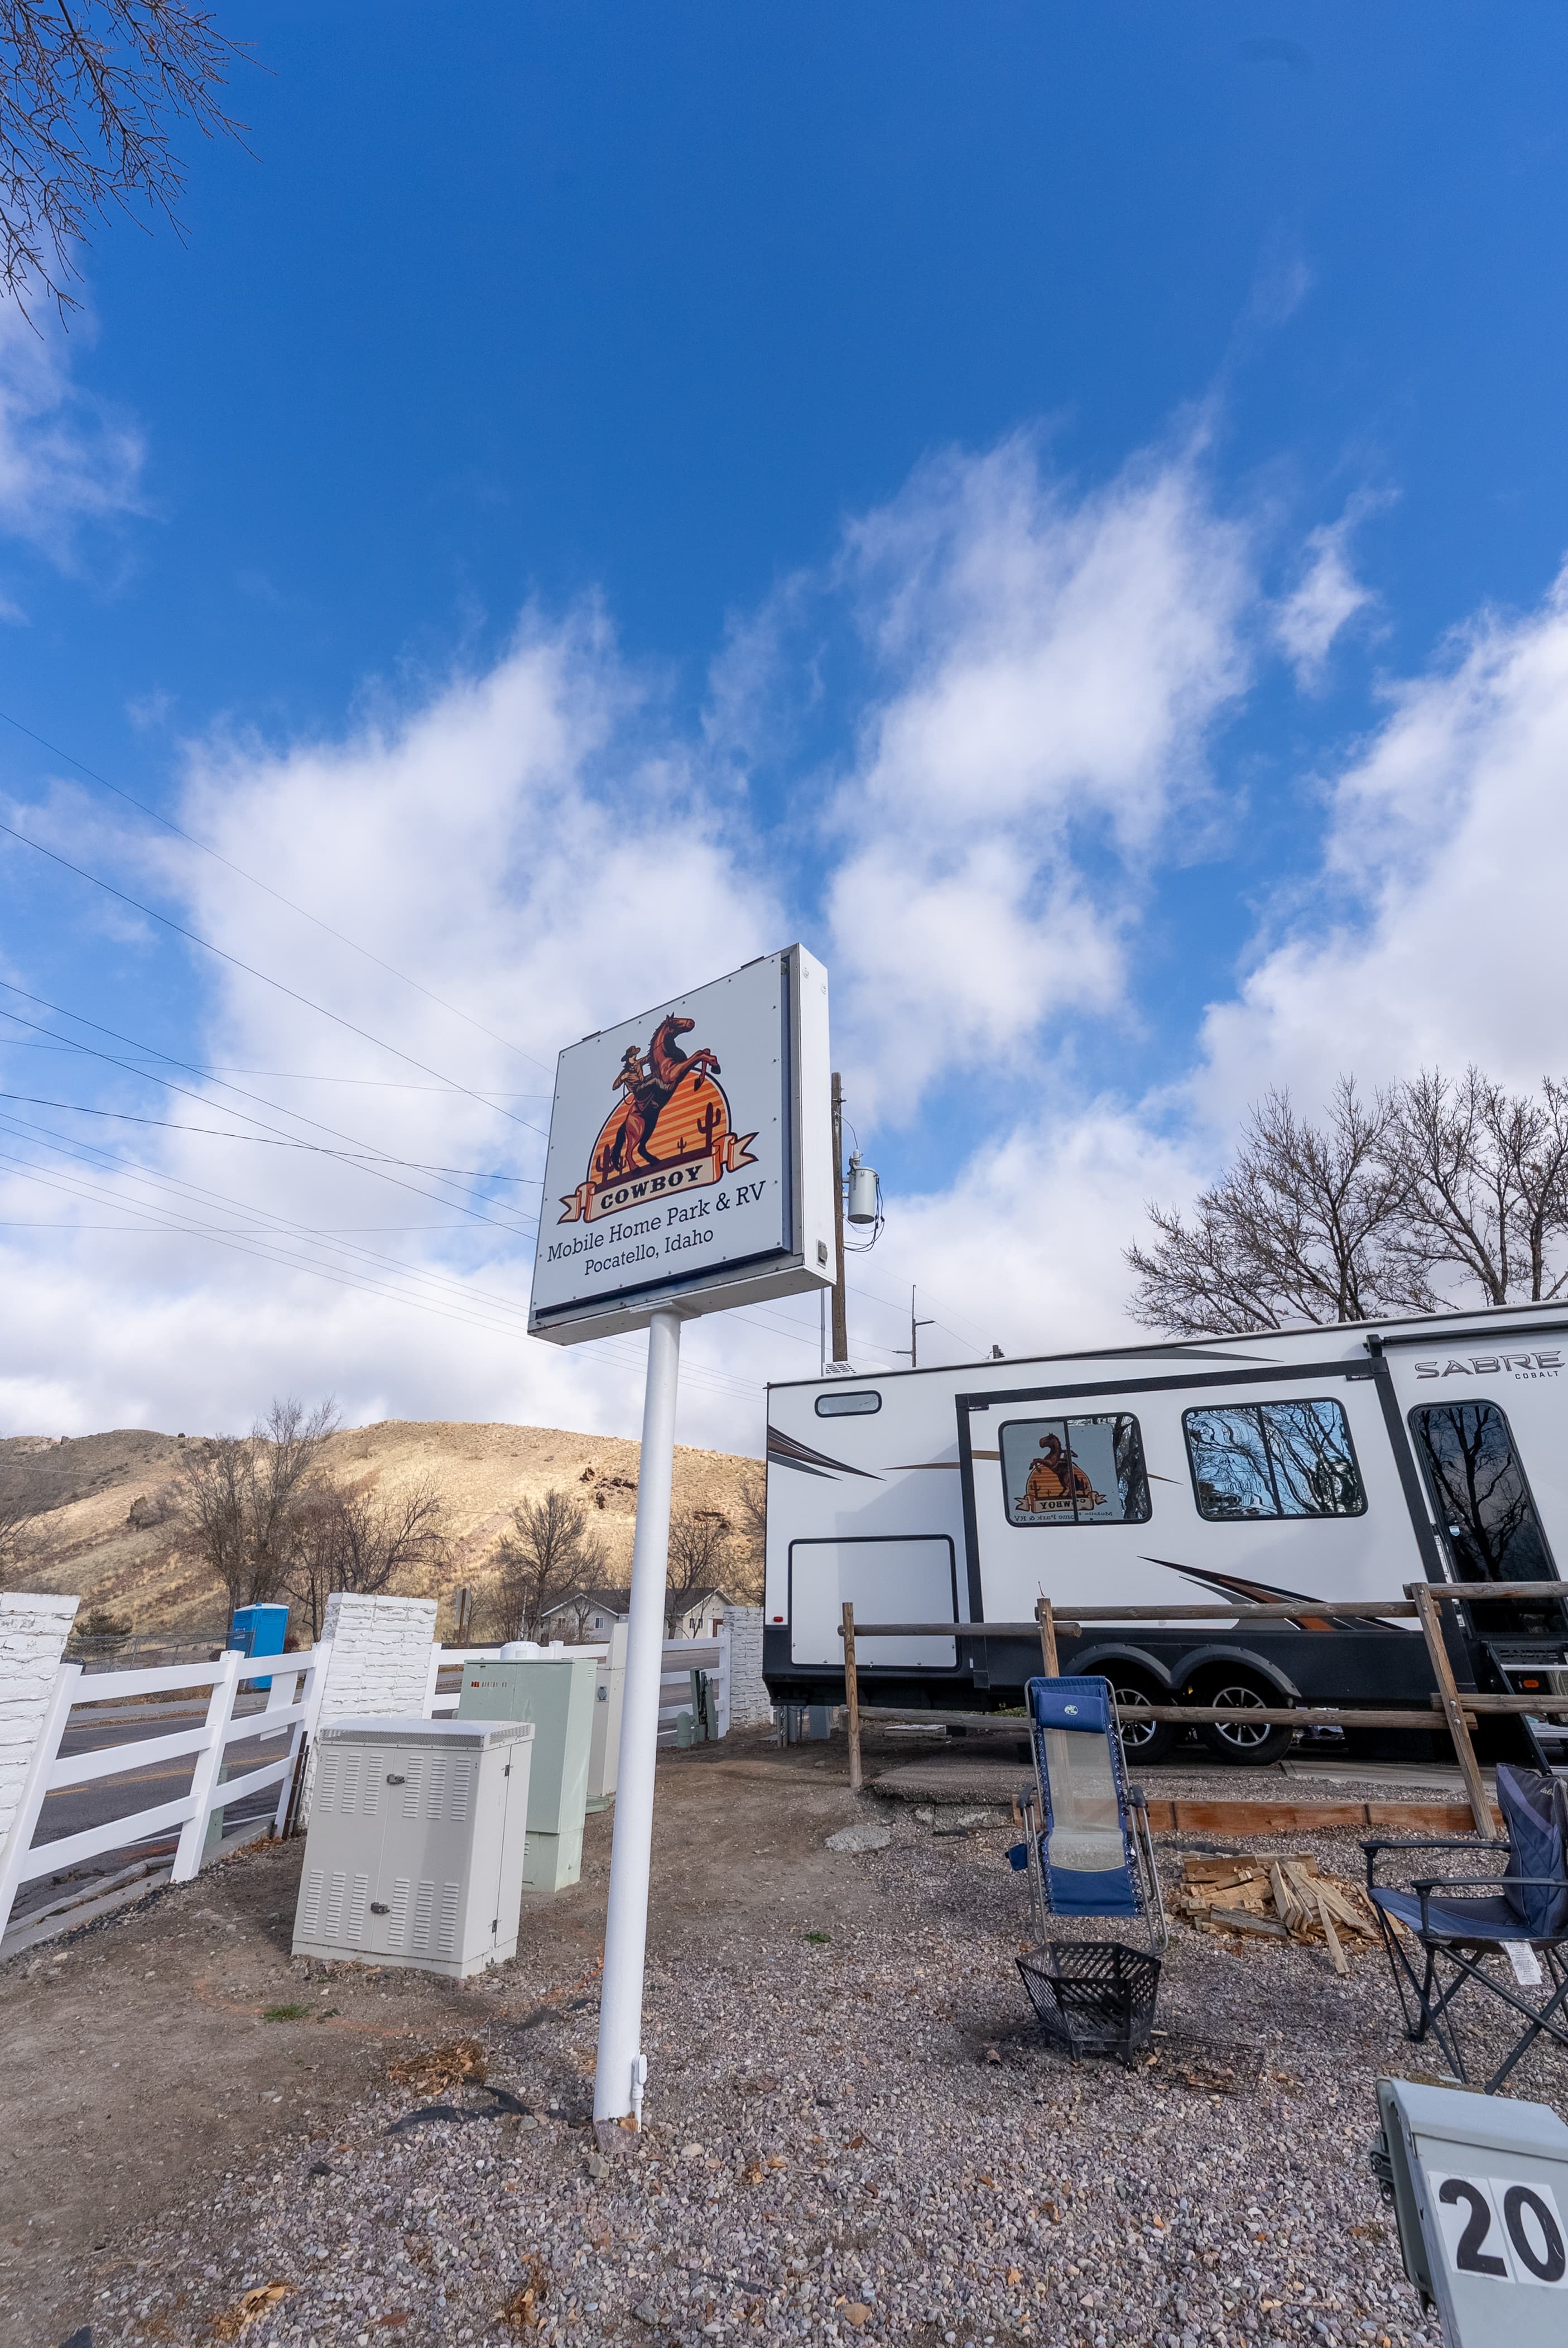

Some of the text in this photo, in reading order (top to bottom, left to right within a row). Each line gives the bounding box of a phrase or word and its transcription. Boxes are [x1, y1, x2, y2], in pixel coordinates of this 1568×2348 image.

[600, 1164, 703, 1210] COWBOY
[547, 1180, 766, 1262] Mobile Home Park & RV
[584, 1229, 714, 1276] Pocatello, Idaho
[1415, 1350, 1565, 1379] SABRE
[1514, 1370, 1559, 1380] COBALT
[1439, 2178, 1566, 2283] 20
